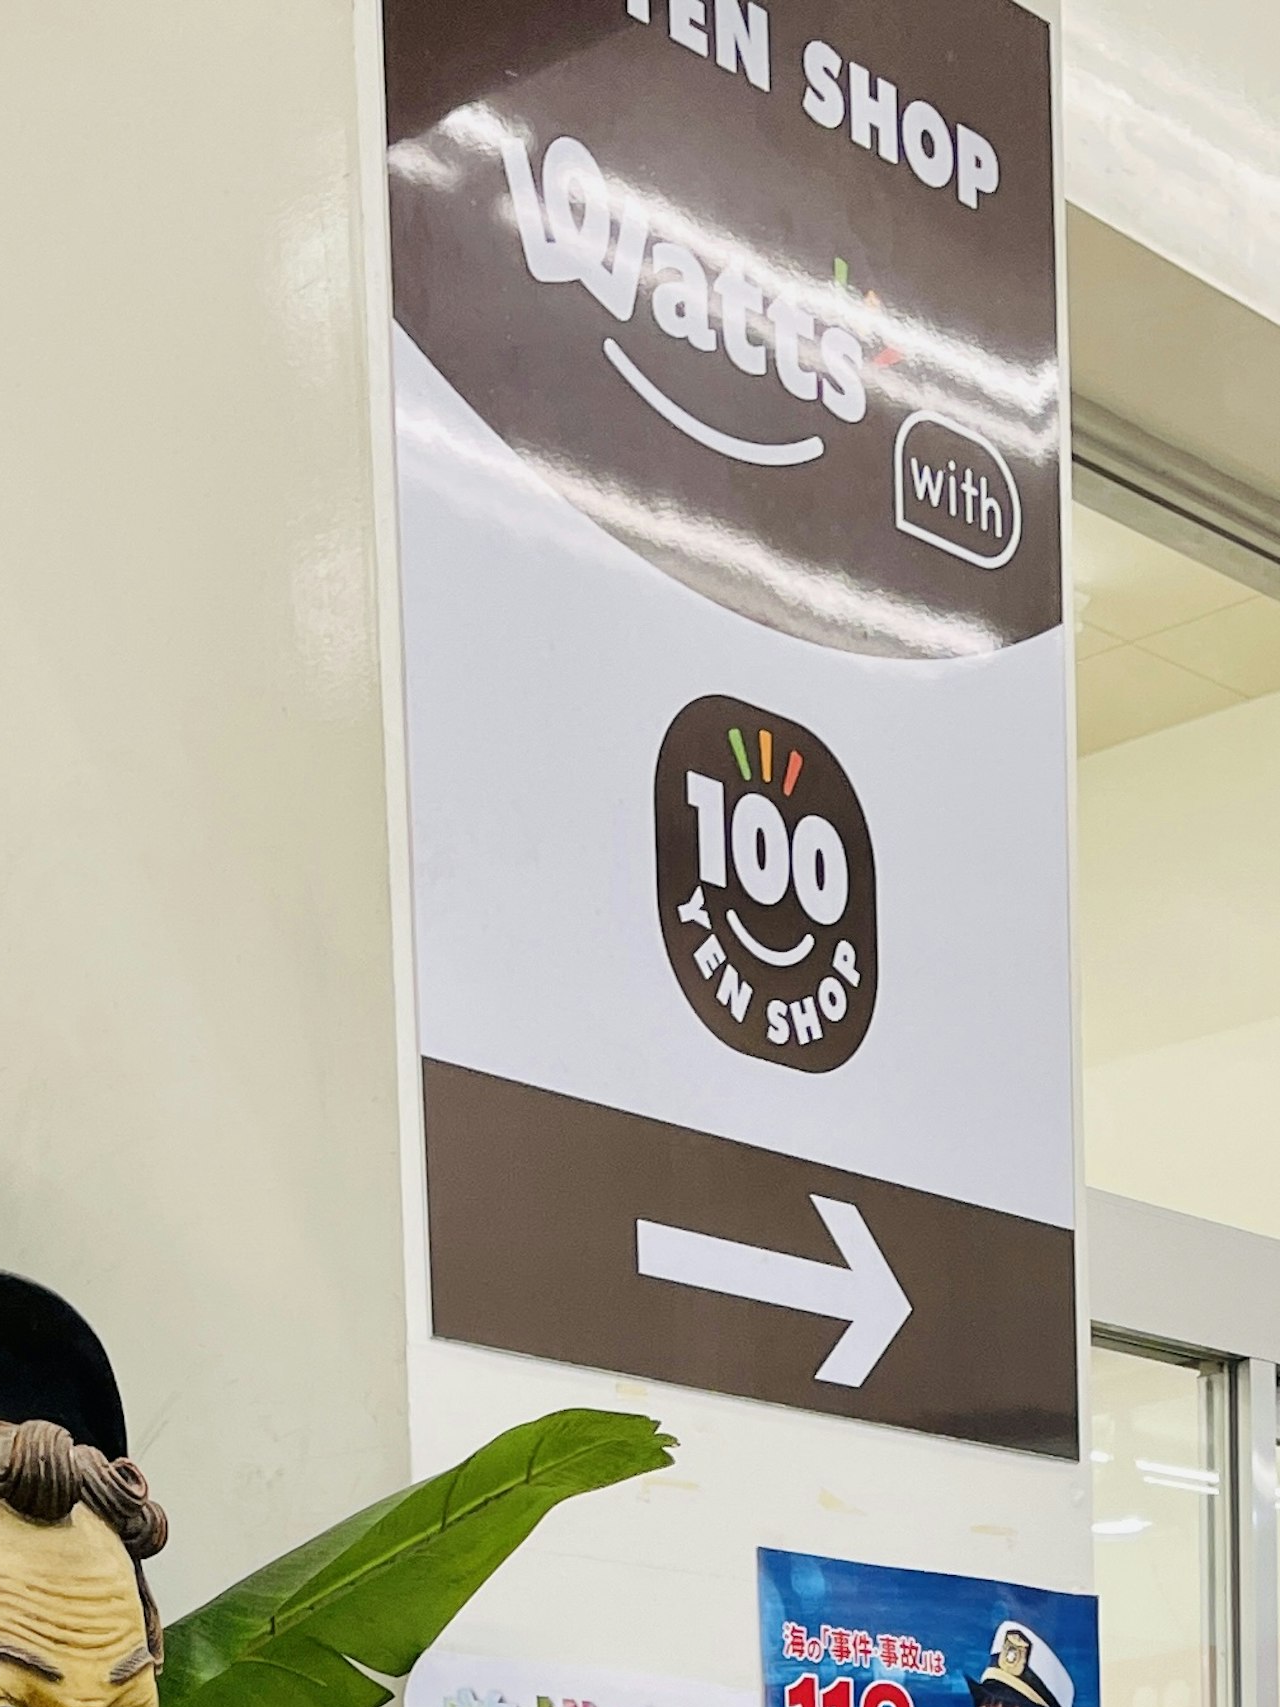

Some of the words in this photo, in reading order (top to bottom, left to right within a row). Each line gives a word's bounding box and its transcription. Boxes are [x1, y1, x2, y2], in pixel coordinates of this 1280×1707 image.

[628, 0, 770, 92] EN
[802, 40, 999, 209] SHOP
[502, 136, 867, 423] Watts
[911, 457, 1003, 538] with
[687, 770, 850, 925] 100
[678, 886, 753, 1023] YEN
[766, 940, 861, 1045] SHOP
